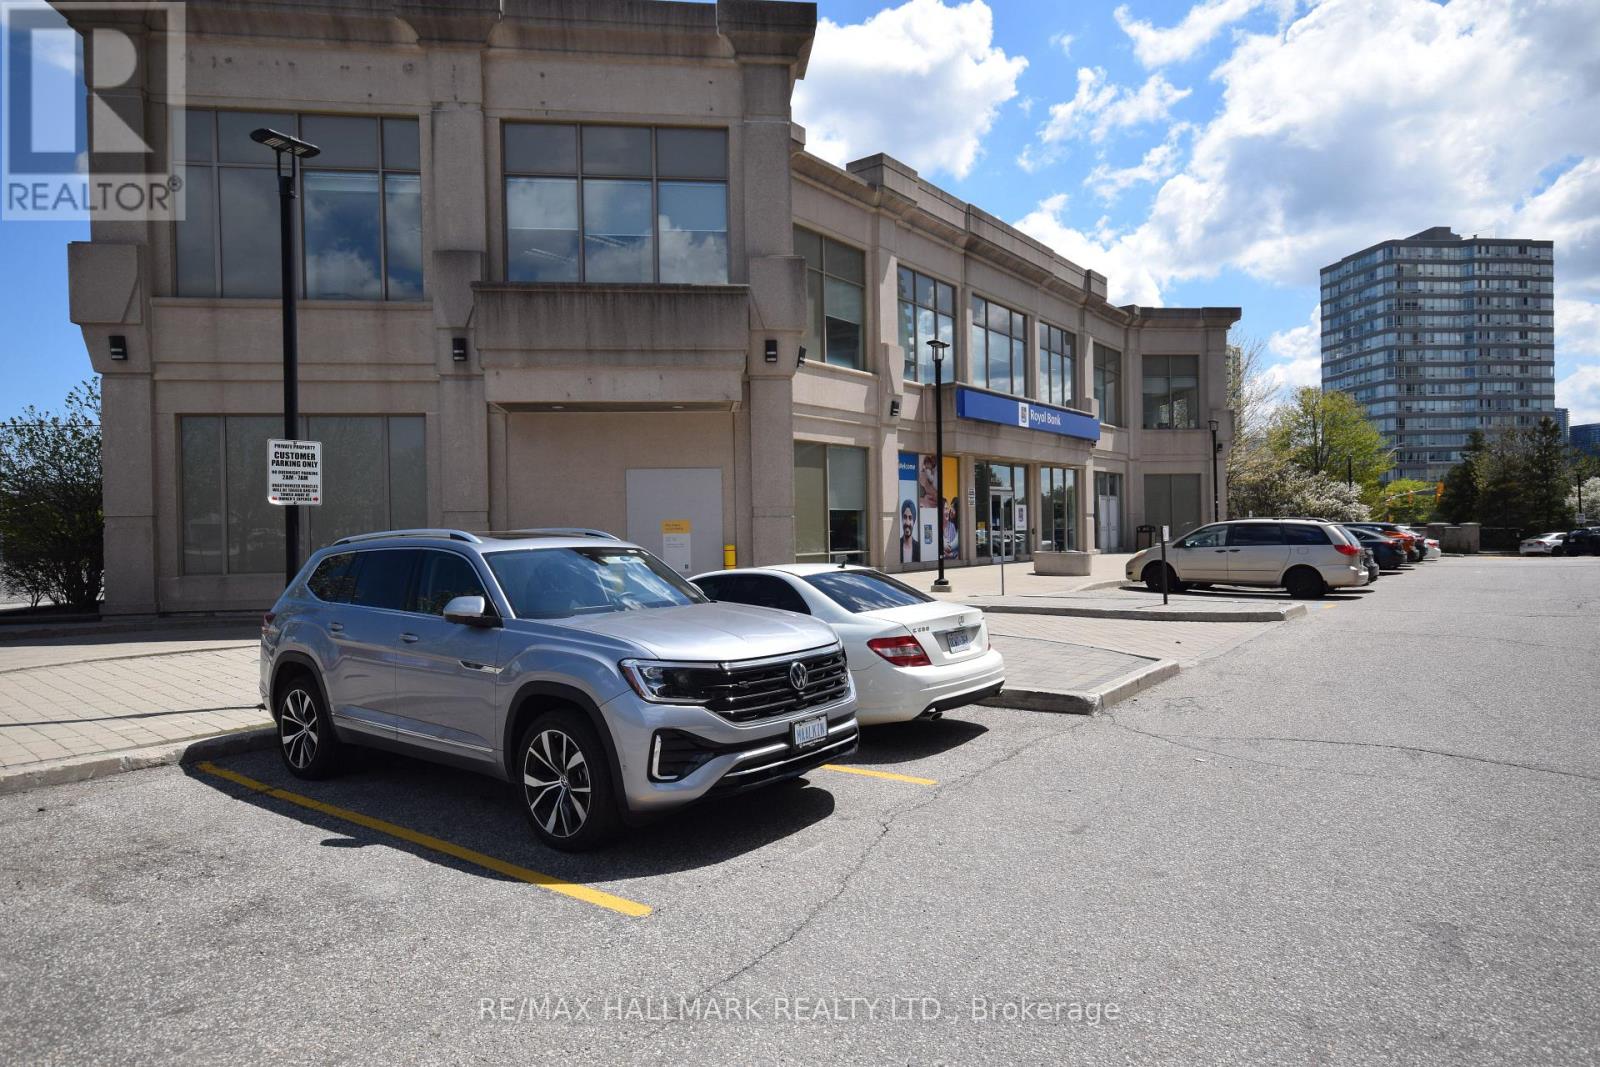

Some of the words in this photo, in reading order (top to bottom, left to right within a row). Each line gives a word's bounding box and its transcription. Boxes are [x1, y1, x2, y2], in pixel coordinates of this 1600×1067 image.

[1030, 409, 1046, 424] Royal
[1047, 413, 1061, 425] Bank
[274, 452, 316, 460] CUSTOMER
